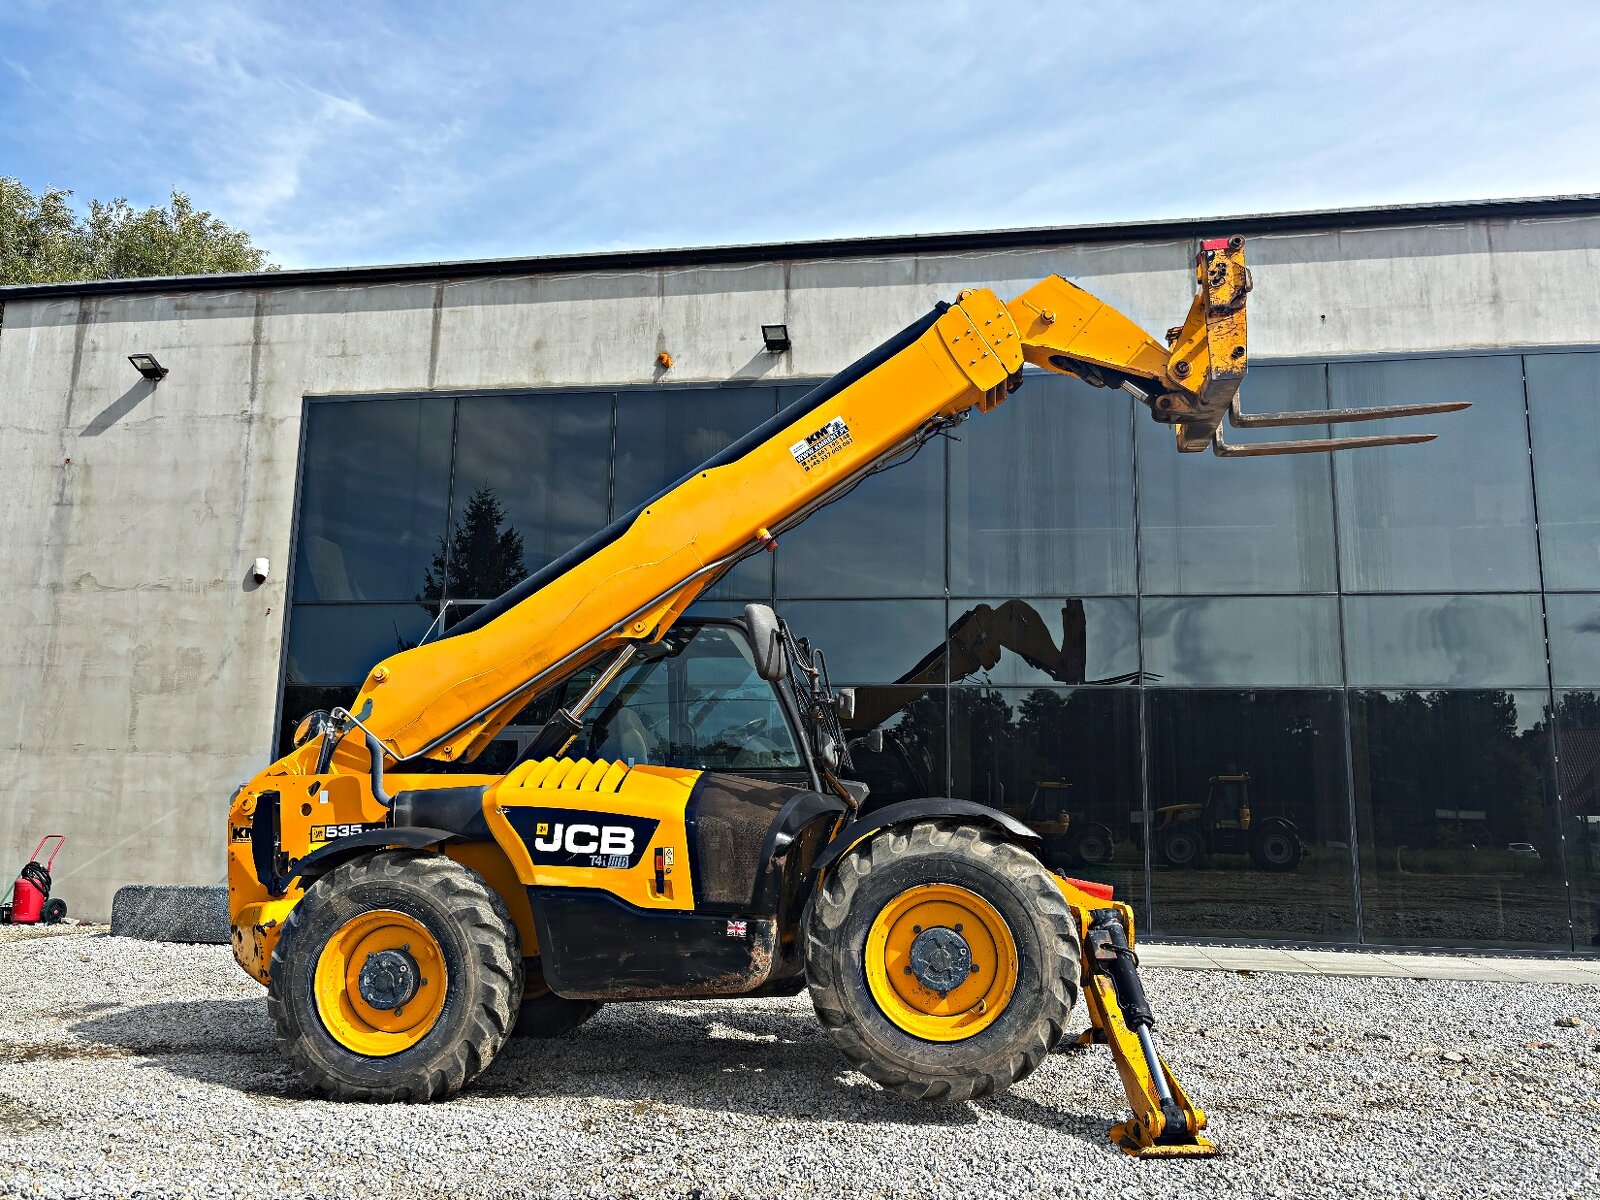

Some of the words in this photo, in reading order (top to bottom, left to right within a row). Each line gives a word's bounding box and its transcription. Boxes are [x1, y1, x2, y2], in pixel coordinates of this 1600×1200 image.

[805, 426, 829, 445] KM
[325, 824, 362, 838] 535
[535, 823, 635, 855] JCB
[589, 855, 606, 867] T4i
